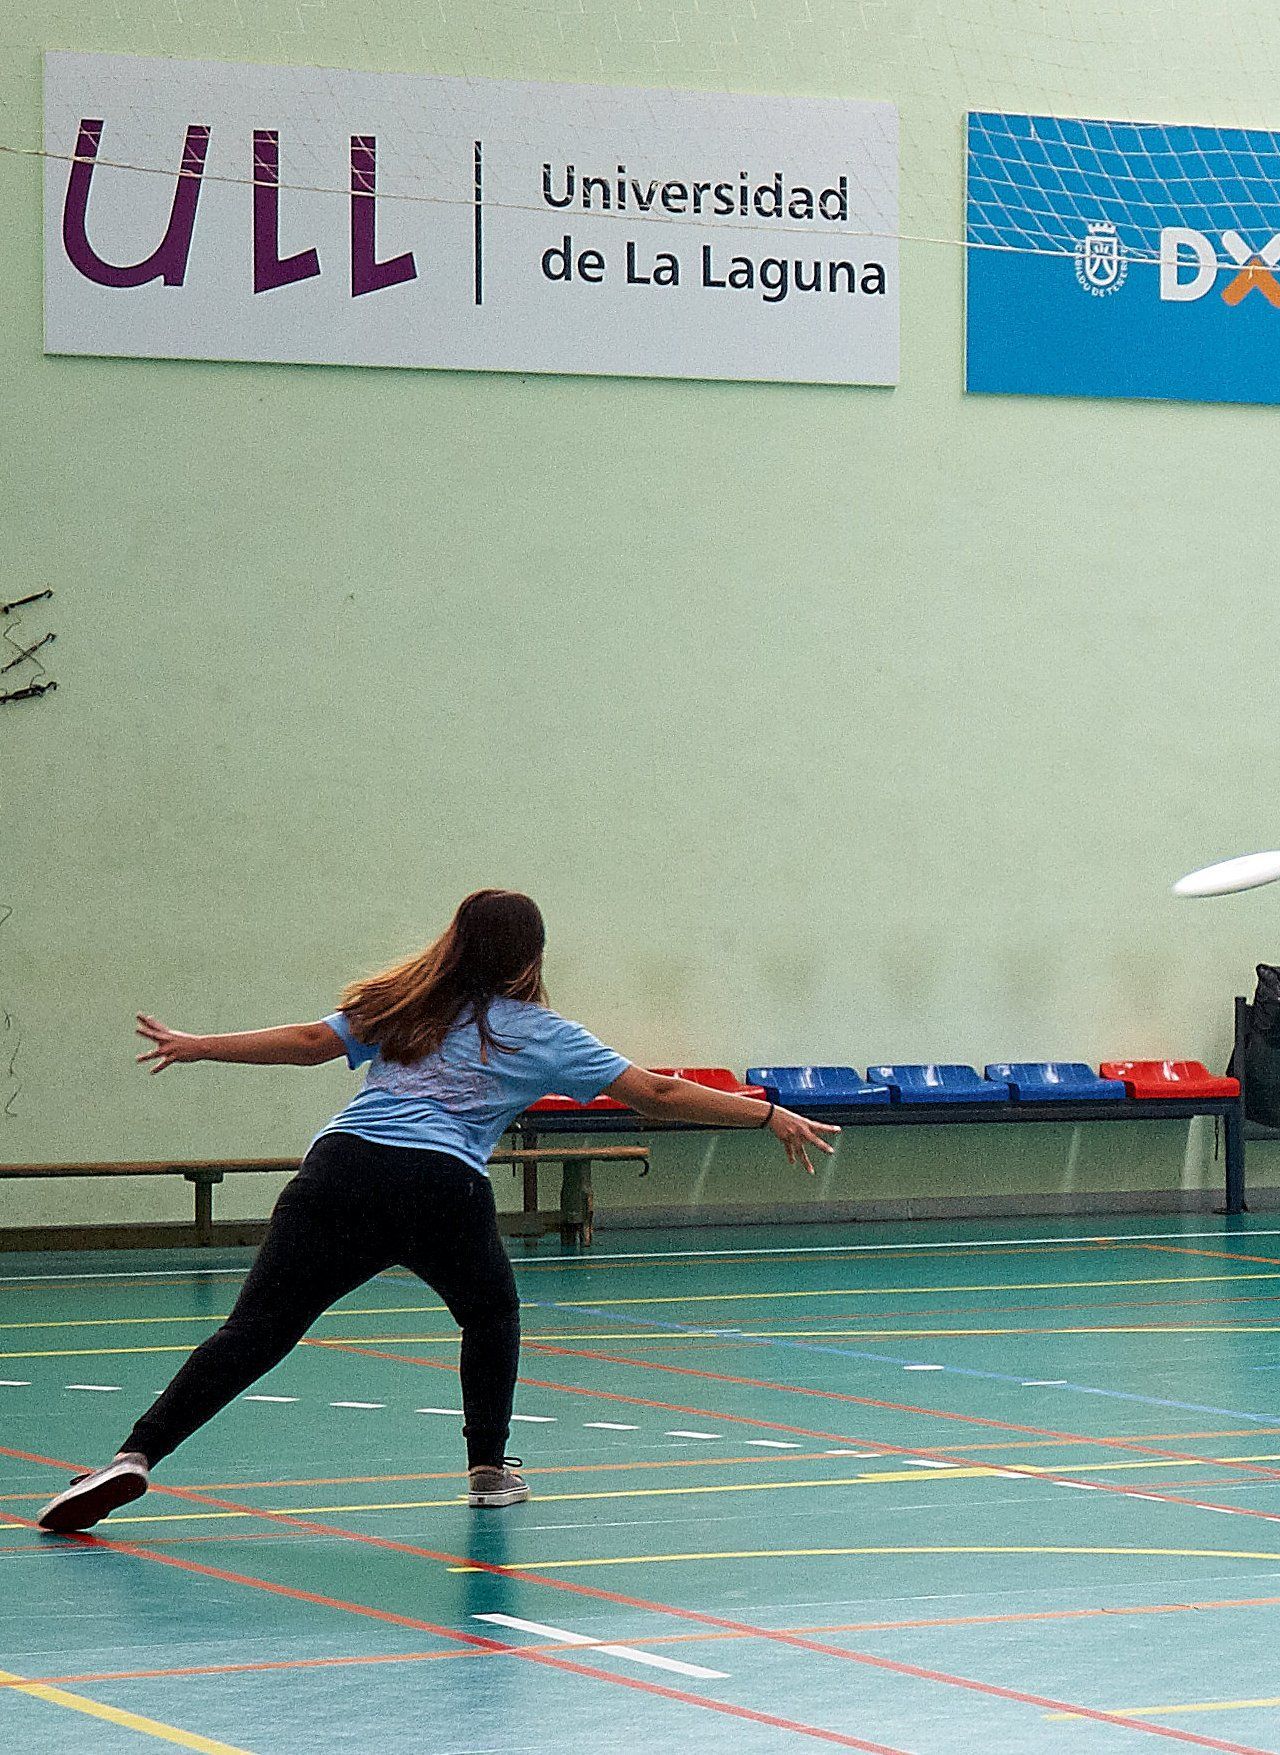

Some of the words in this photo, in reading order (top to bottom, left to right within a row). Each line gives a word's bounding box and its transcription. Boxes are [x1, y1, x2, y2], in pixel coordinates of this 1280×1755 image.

[62, 118, 418, 299] ULL
[542, 163, 848, 222] Universidad
[541, 235, 605, 284] de
[626, 241, 680, 287] La
[702, 245, 888, 303] Laguna
